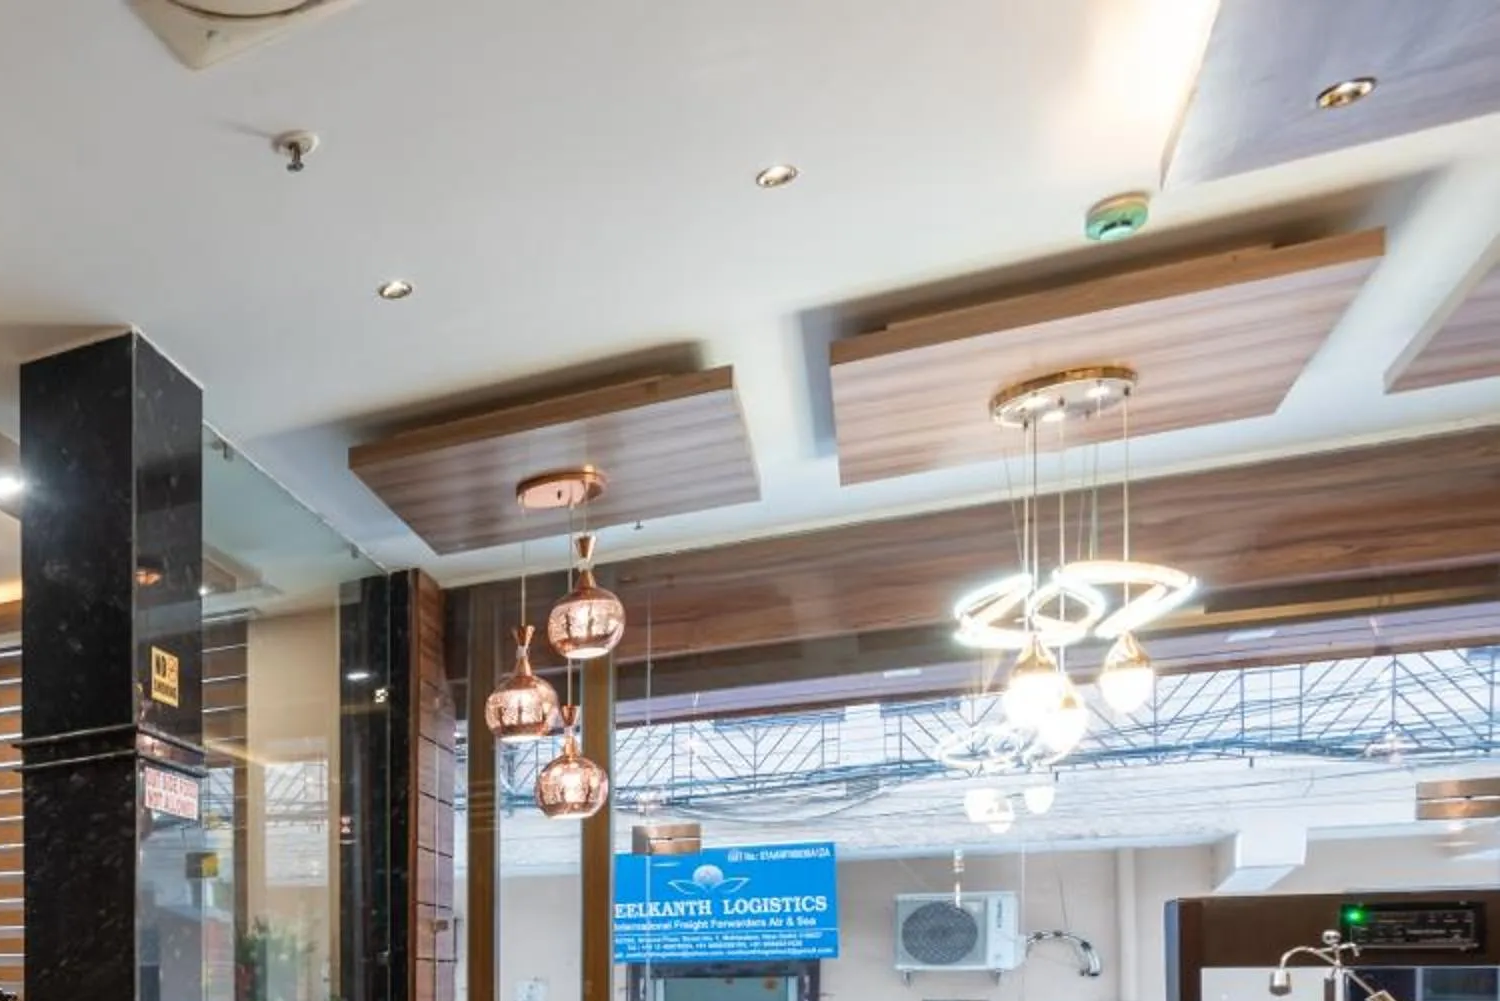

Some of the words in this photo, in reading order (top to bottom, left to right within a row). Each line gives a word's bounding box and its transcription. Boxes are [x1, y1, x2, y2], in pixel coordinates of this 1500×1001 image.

[155, 653, 167, 678] NO
[723, 896, 827, 915] LOGISTICS
[673, 919, 709, 932] Freight
[710, 918, 766, 929] Forwarders
[769, 917, 783, 927] Air
[796, 916, 817, 926] Sea
